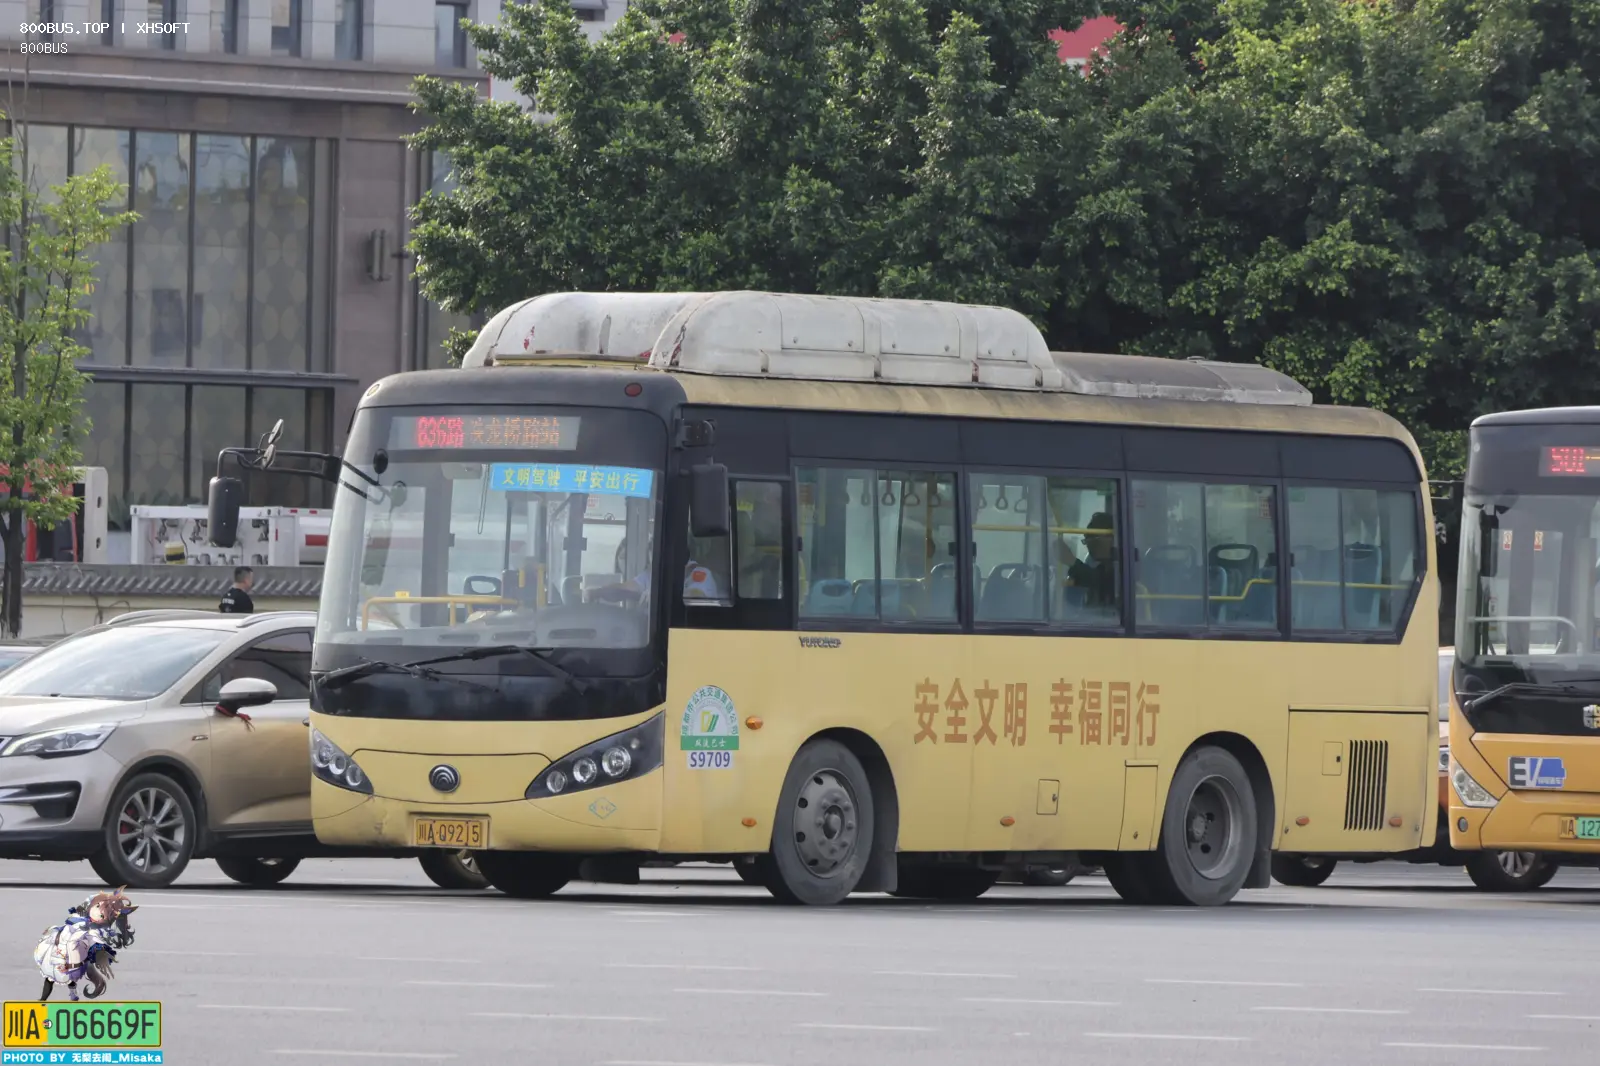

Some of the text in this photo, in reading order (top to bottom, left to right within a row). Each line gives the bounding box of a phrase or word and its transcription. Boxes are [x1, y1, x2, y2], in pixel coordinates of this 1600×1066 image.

[502, 467, 640, 491] 文明驾驶 平安出行
[913, 677, 1161, 747] 安全文明 幸福同行
[689, 751, 731, 768] S9709
